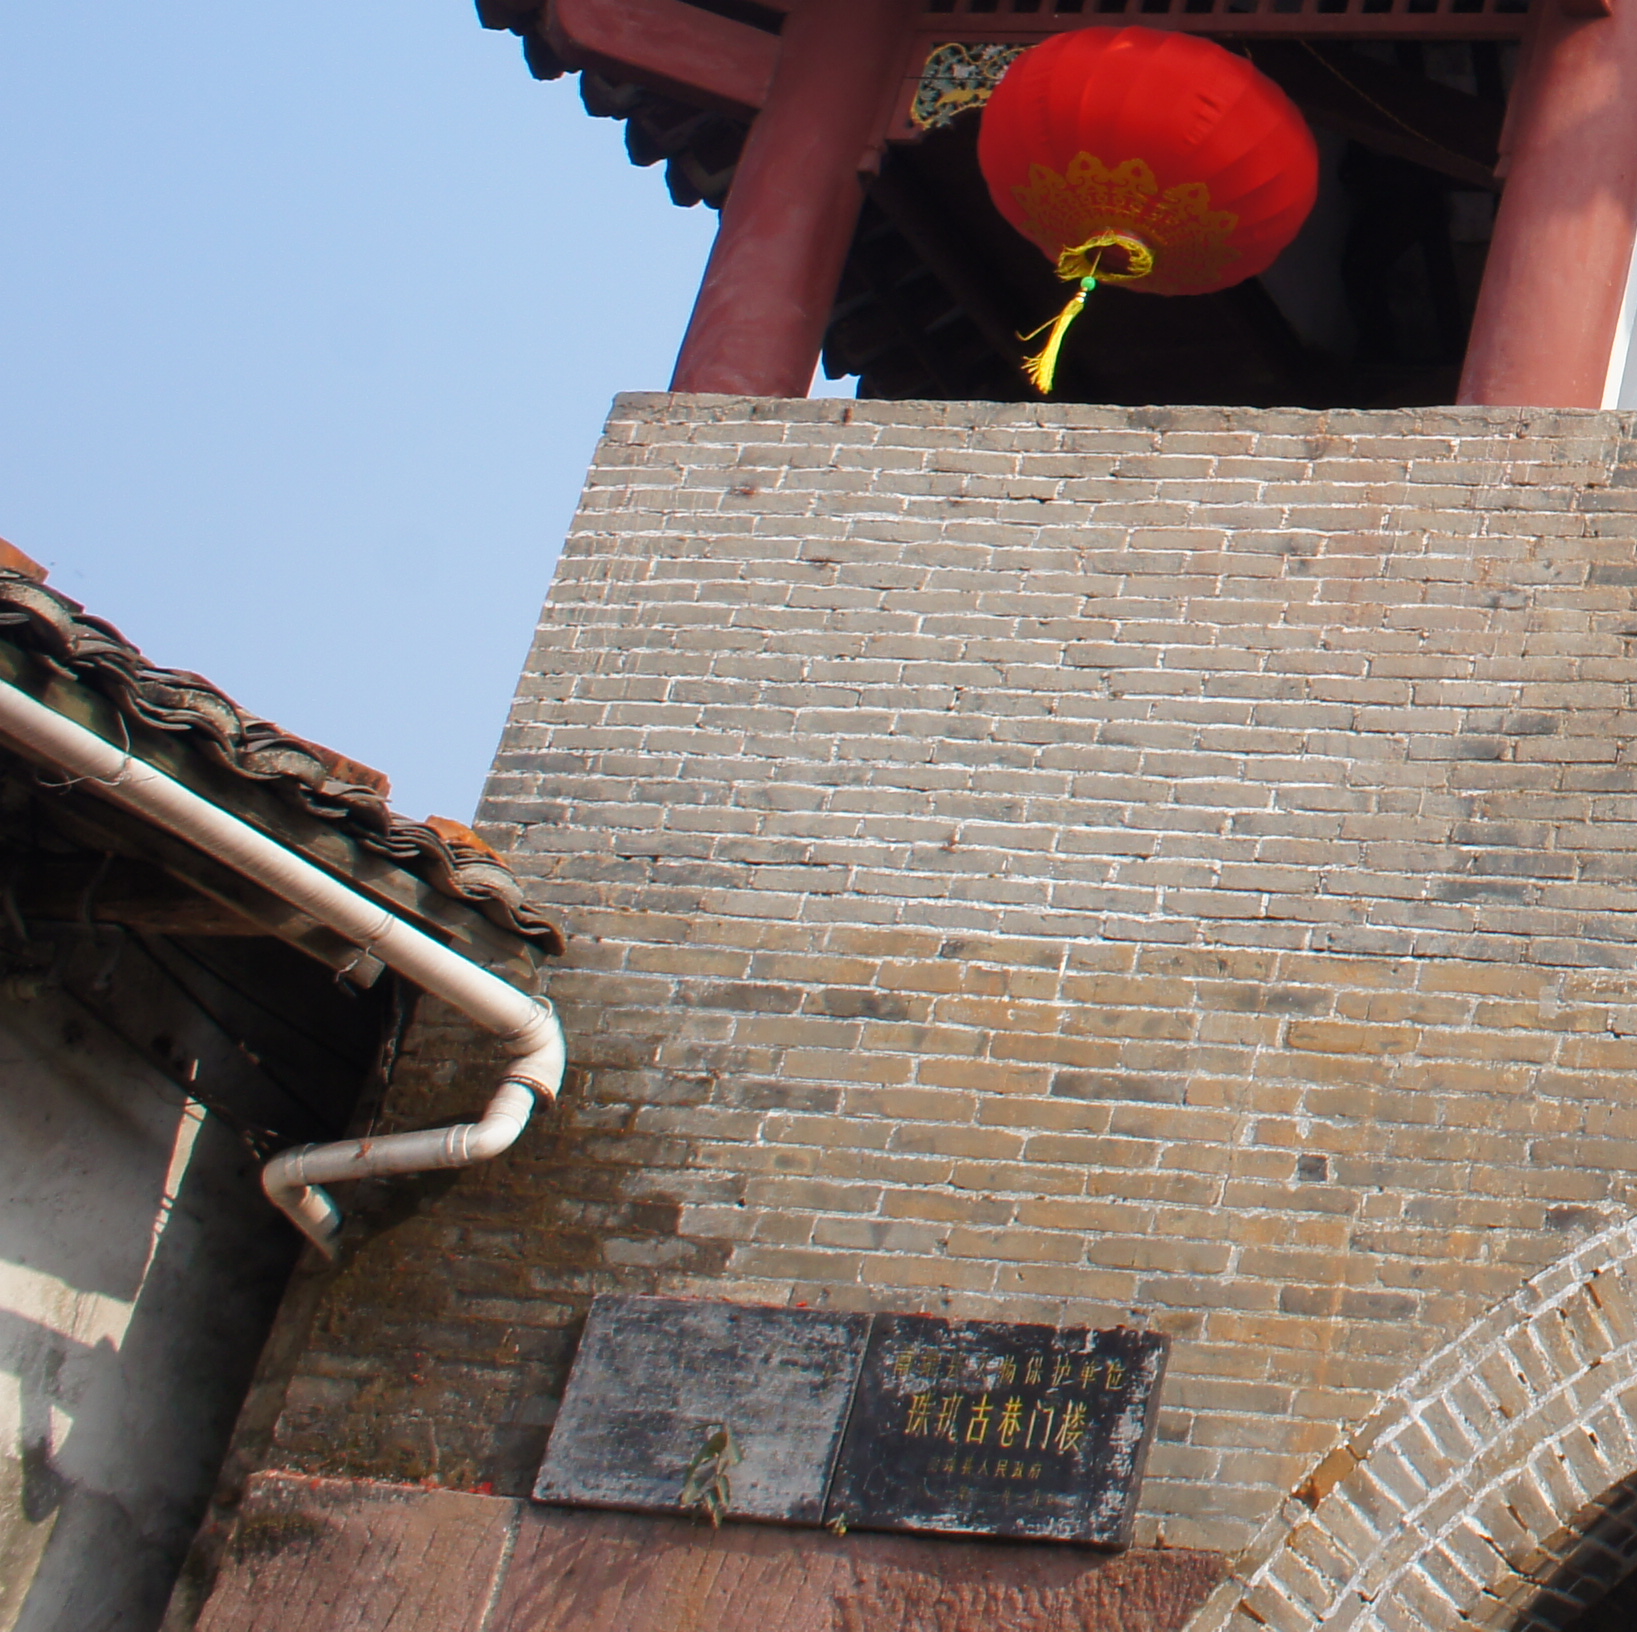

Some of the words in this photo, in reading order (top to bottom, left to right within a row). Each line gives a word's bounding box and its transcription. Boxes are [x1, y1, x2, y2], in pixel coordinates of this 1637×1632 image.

[904, 1391, 1087, 1455] 珠玑古巷门楼
